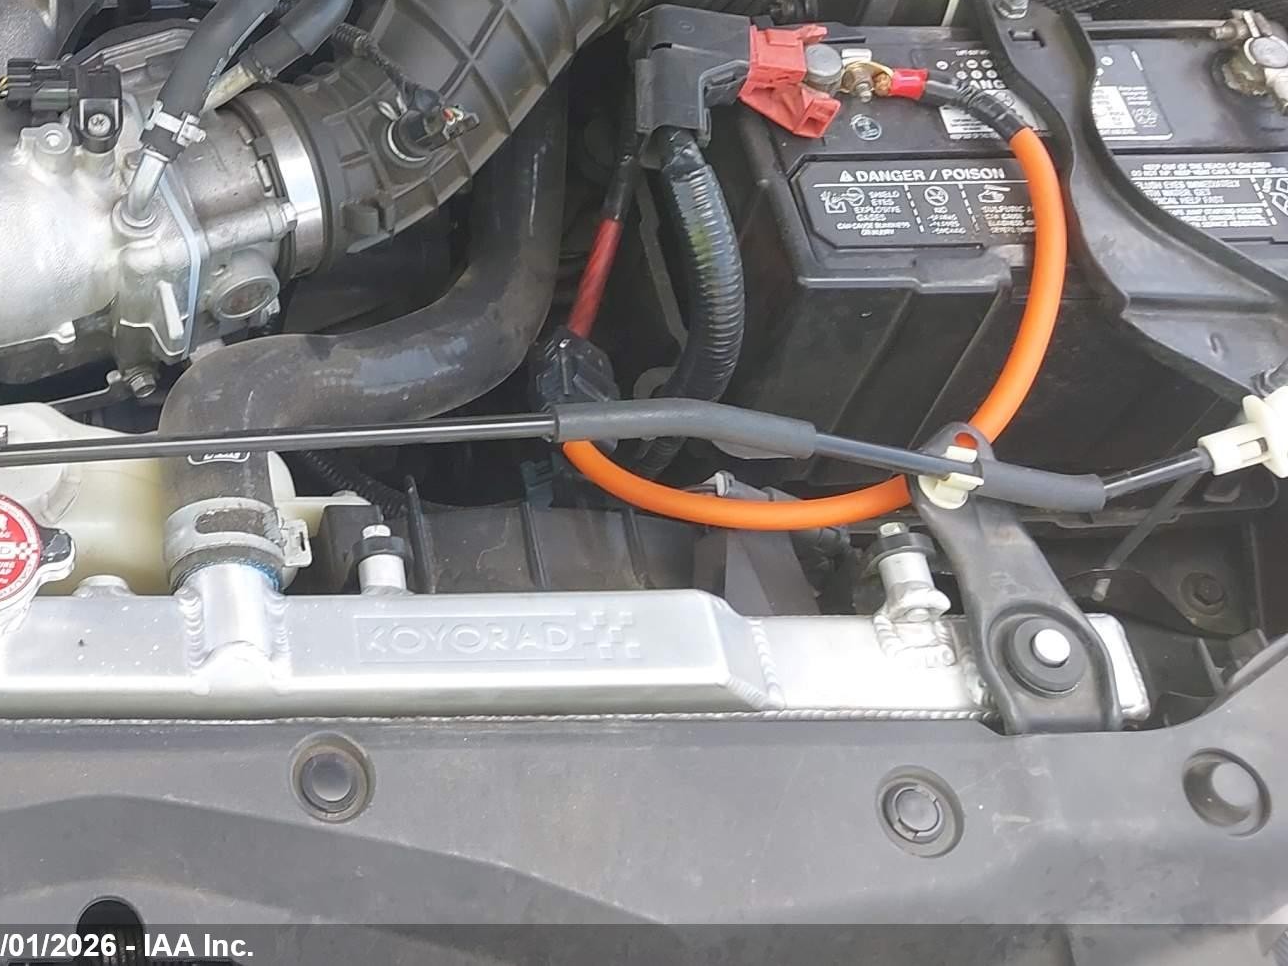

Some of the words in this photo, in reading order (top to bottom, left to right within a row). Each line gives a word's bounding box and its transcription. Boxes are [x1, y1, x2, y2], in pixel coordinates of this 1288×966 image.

[855, 170, 926, 183] DANGER
[941, 167, 1005, 181] POISON
[871, 198, 895, 206] EYES
[364, 620, 575, 655] KOYORAD
